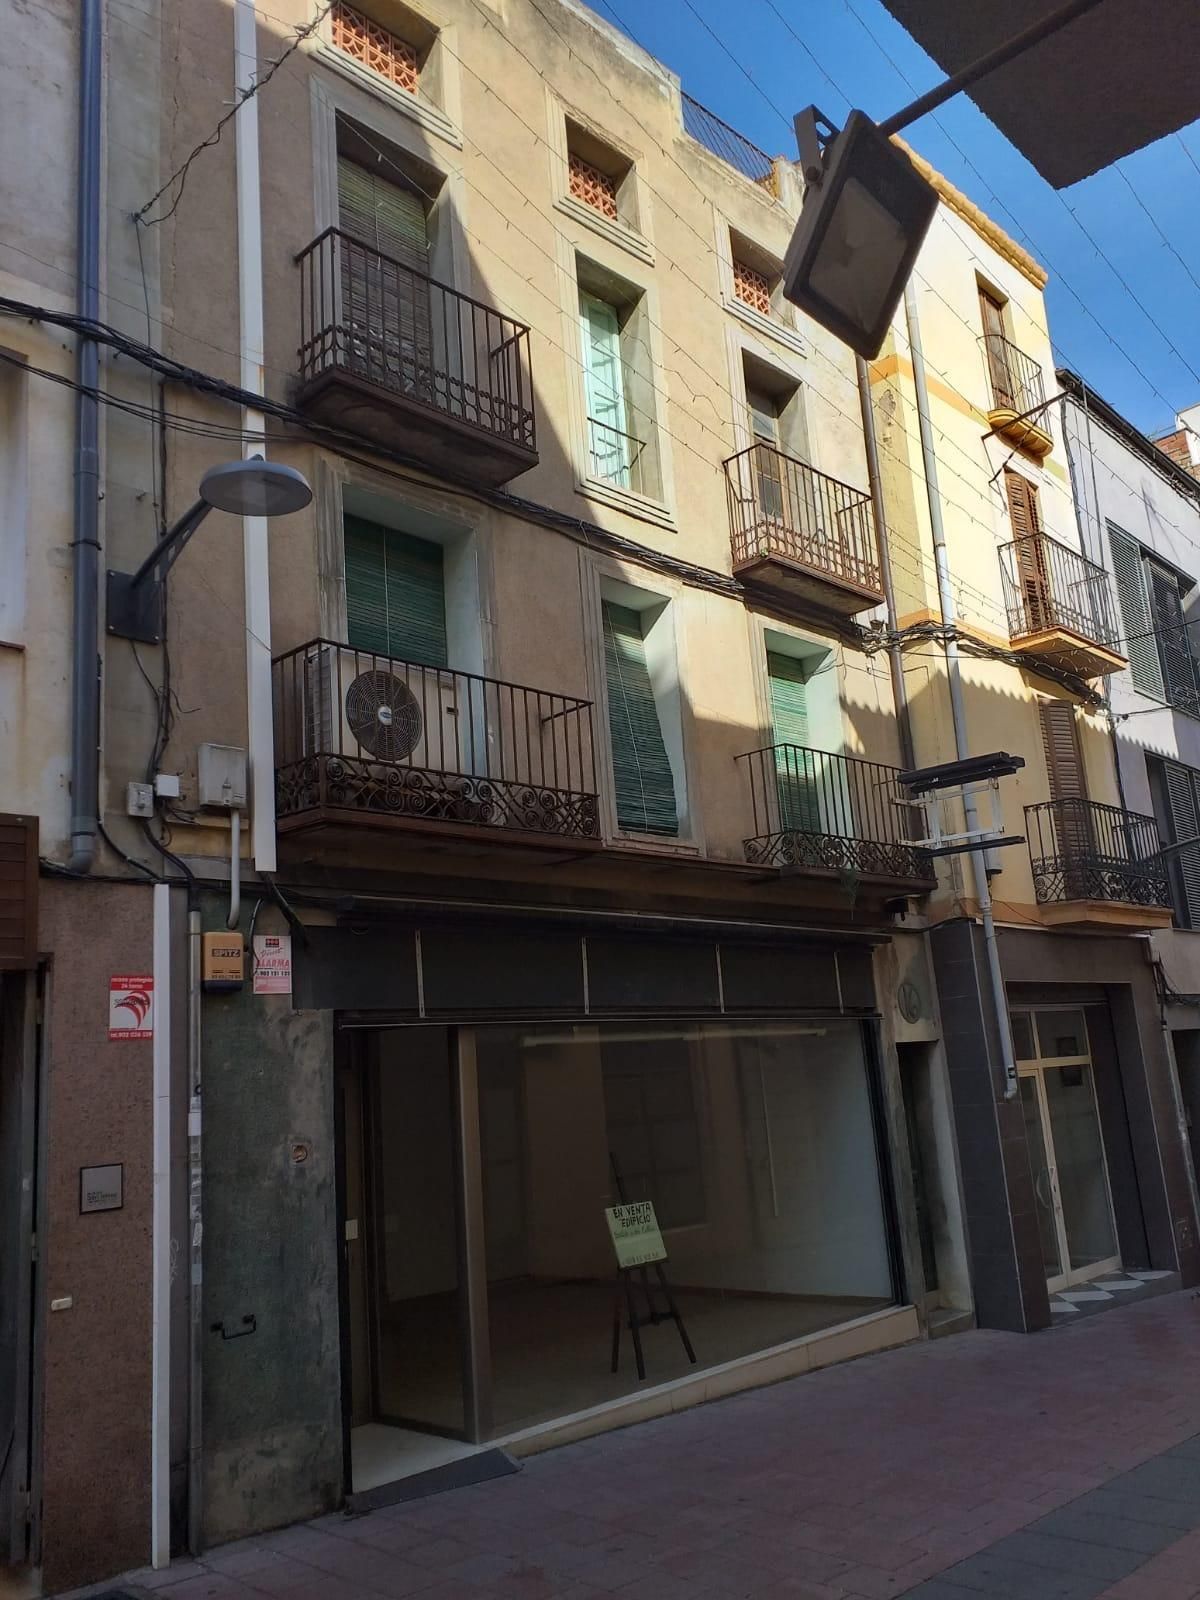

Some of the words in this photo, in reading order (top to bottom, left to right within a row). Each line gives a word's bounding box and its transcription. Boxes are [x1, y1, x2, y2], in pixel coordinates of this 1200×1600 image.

[212, 949, 240, 957] SPITZ
[613, 1208, 624, 1218] EN
[626, 1203, 650, 1216] VENTA
[622, 1215, 651, 1228] EDIFICIO
